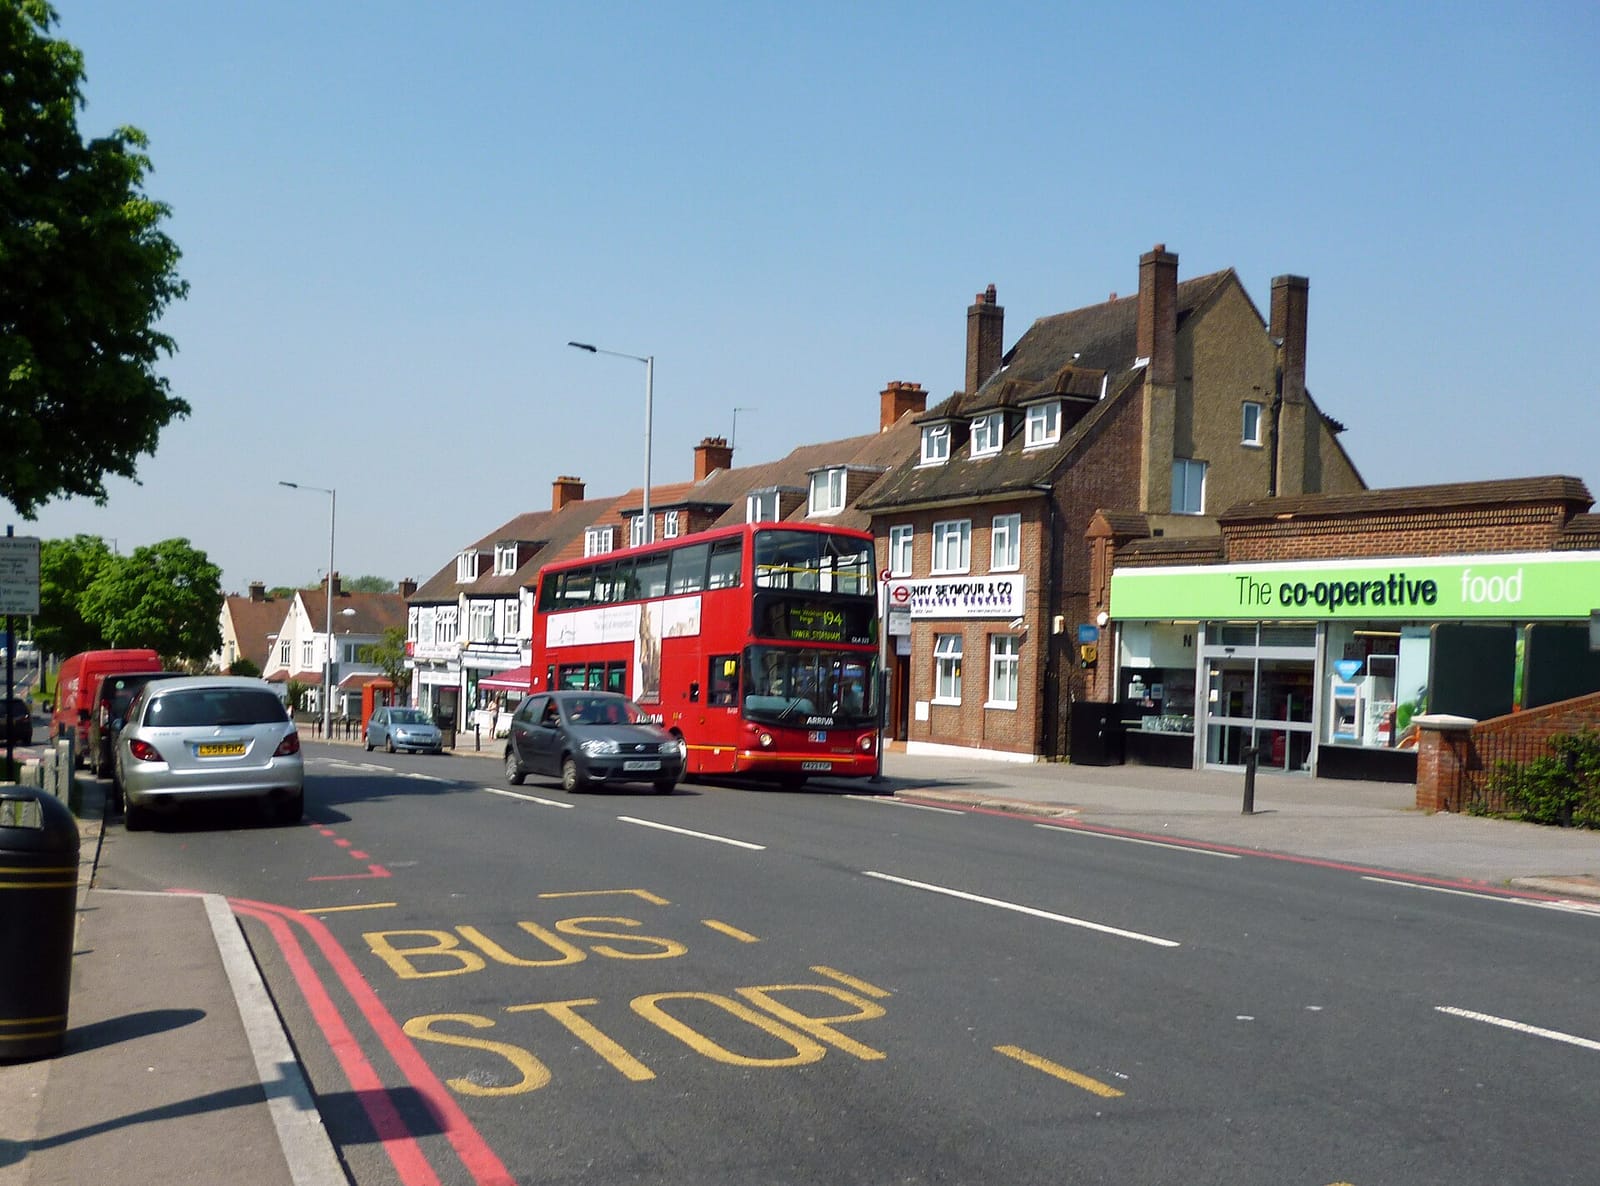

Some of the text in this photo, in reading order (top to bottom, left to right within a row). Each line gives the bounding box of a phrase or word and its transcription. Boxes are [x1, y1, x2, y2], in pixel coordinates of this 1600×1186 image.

[936, 583, 985, 597] SEYMOUR
[997, 581, 1013, 595] CO
[1236, 567, 1522, 614] The co-operative food
[823, 610, 843, 626] 194
[806, 716, 834, 726] ARRIVA
[362, 916, 689, 979] BUS
[402, 983, 888, 1097] STOP
